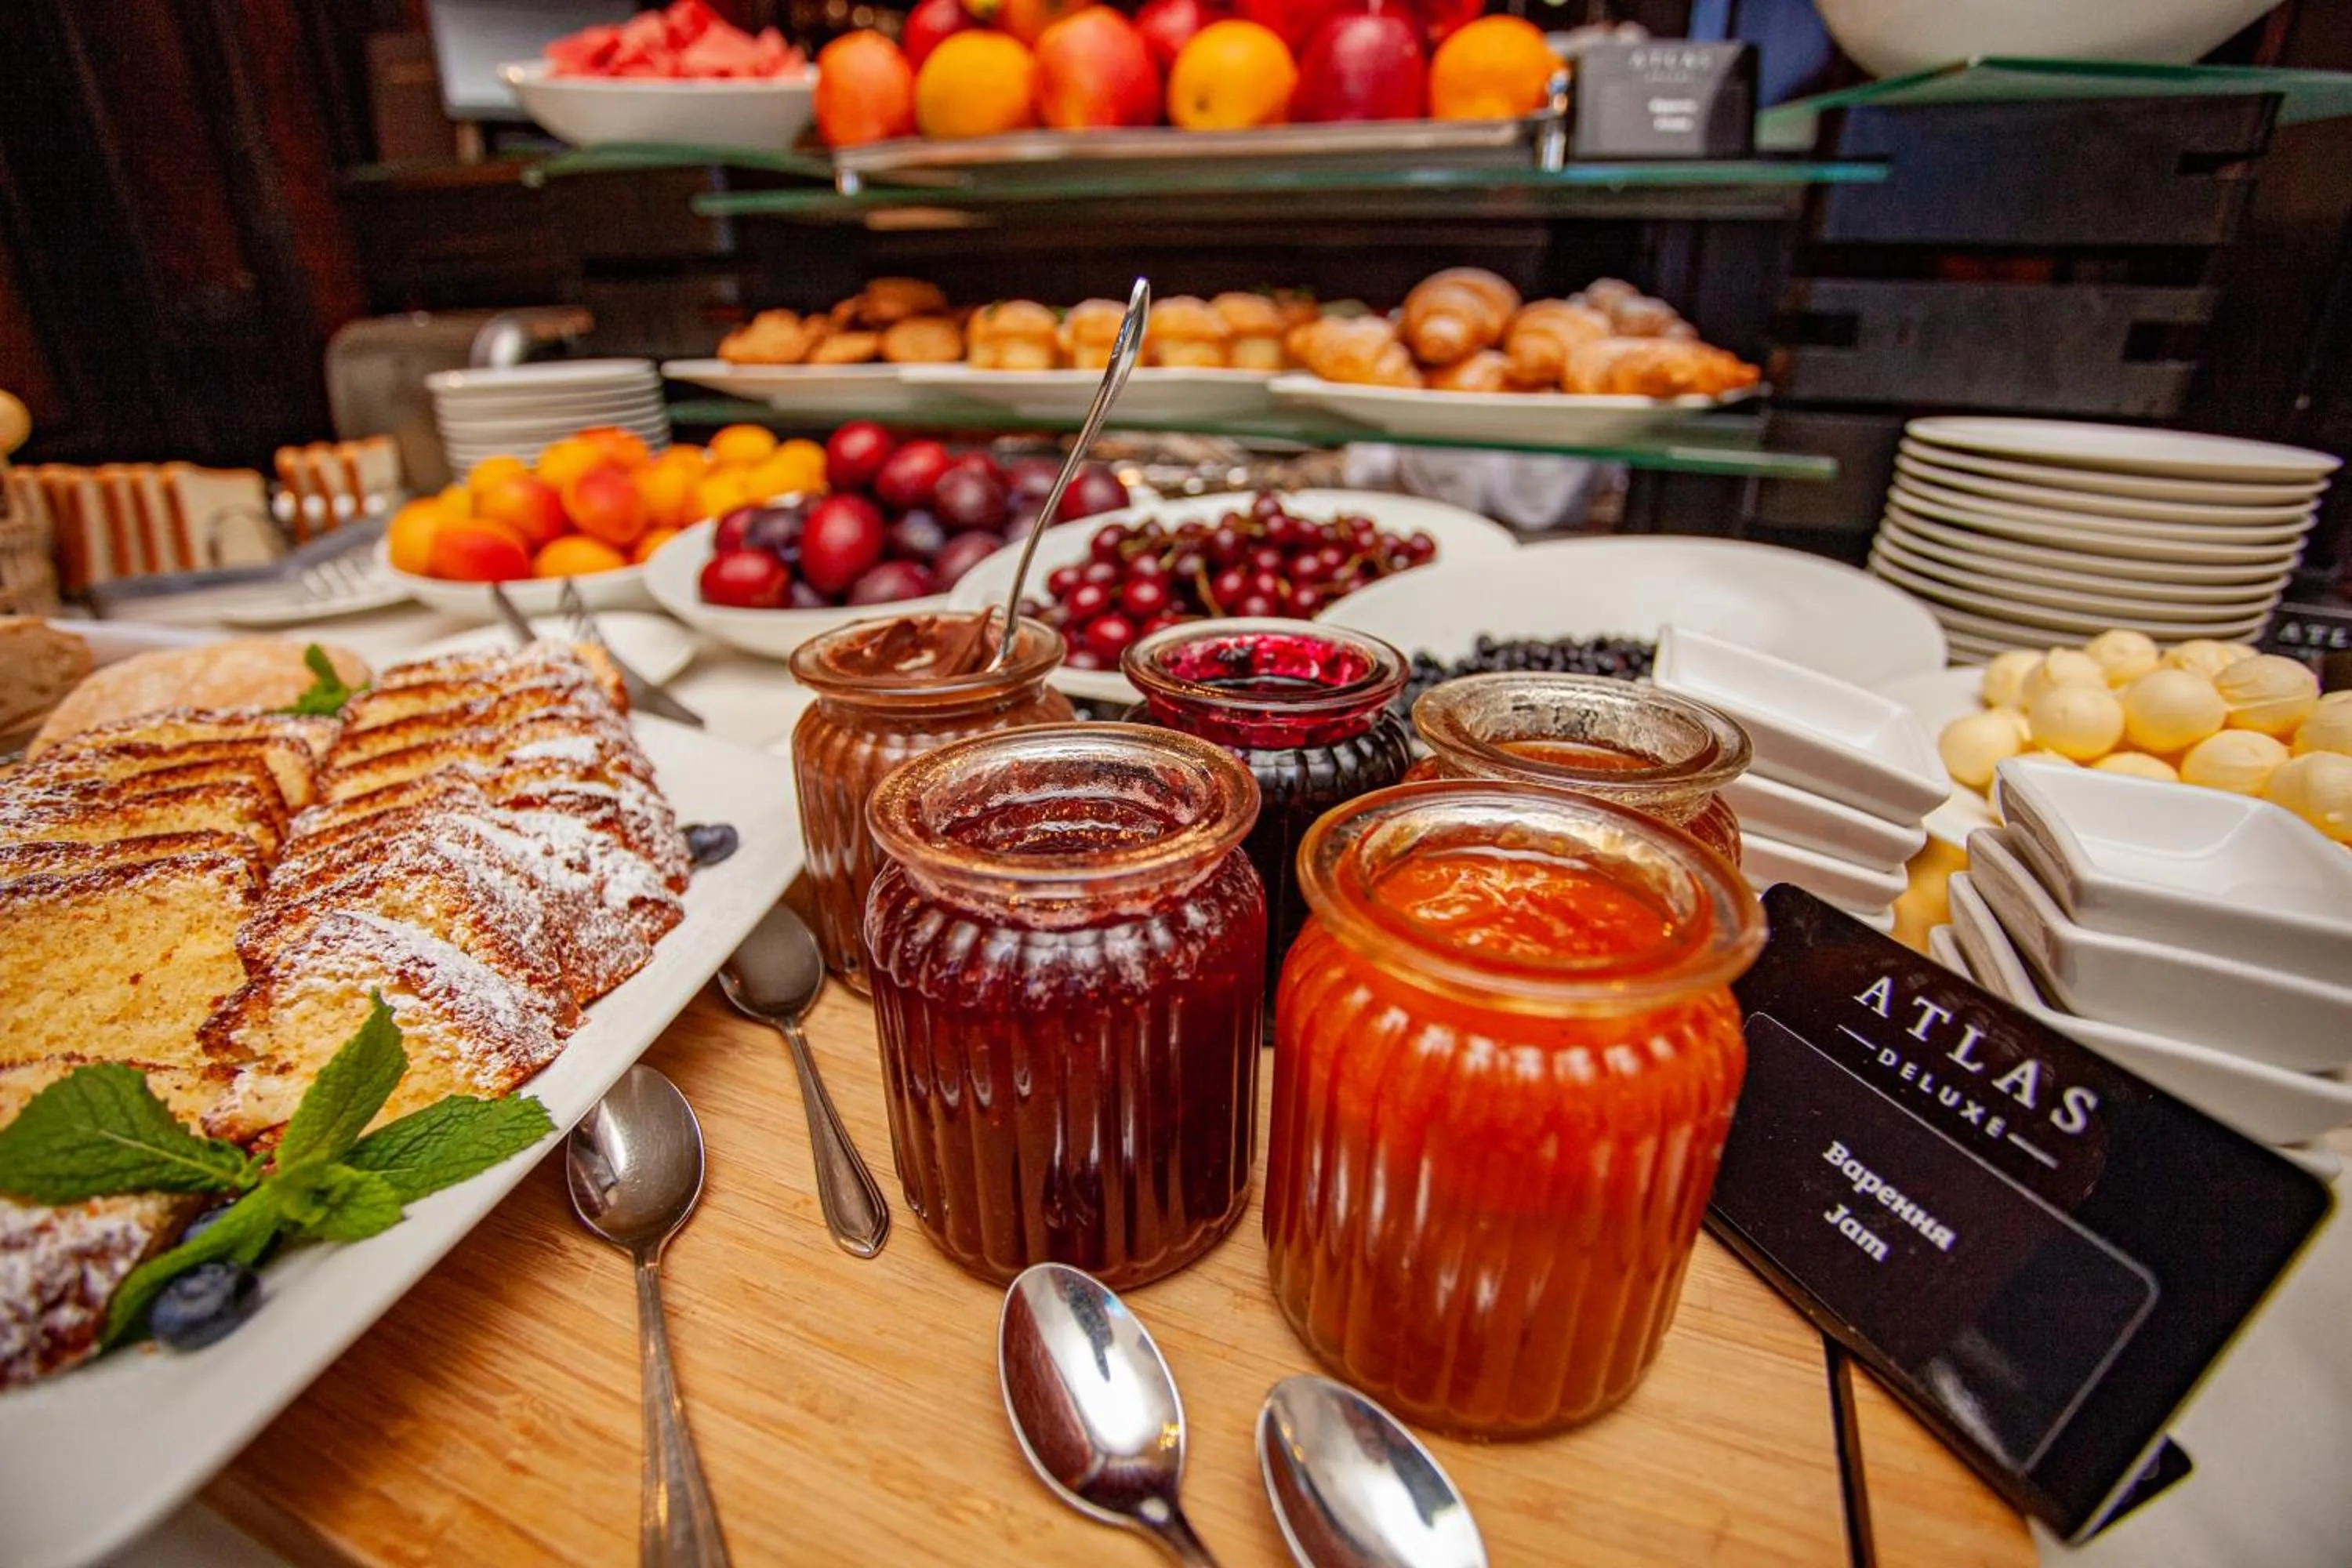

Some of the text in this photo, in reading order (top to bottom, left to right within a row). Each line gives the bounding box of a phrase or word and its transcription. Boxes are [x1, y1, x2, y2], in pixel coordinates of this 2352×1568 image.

[1853, 975, 2099, 1134] ATLAS
[1877, 1048, 2006, 1138] DELUXE
[1823, 1141, 1956, 1251] Варення
[1824, 1204, 1889, 1262] Jam
